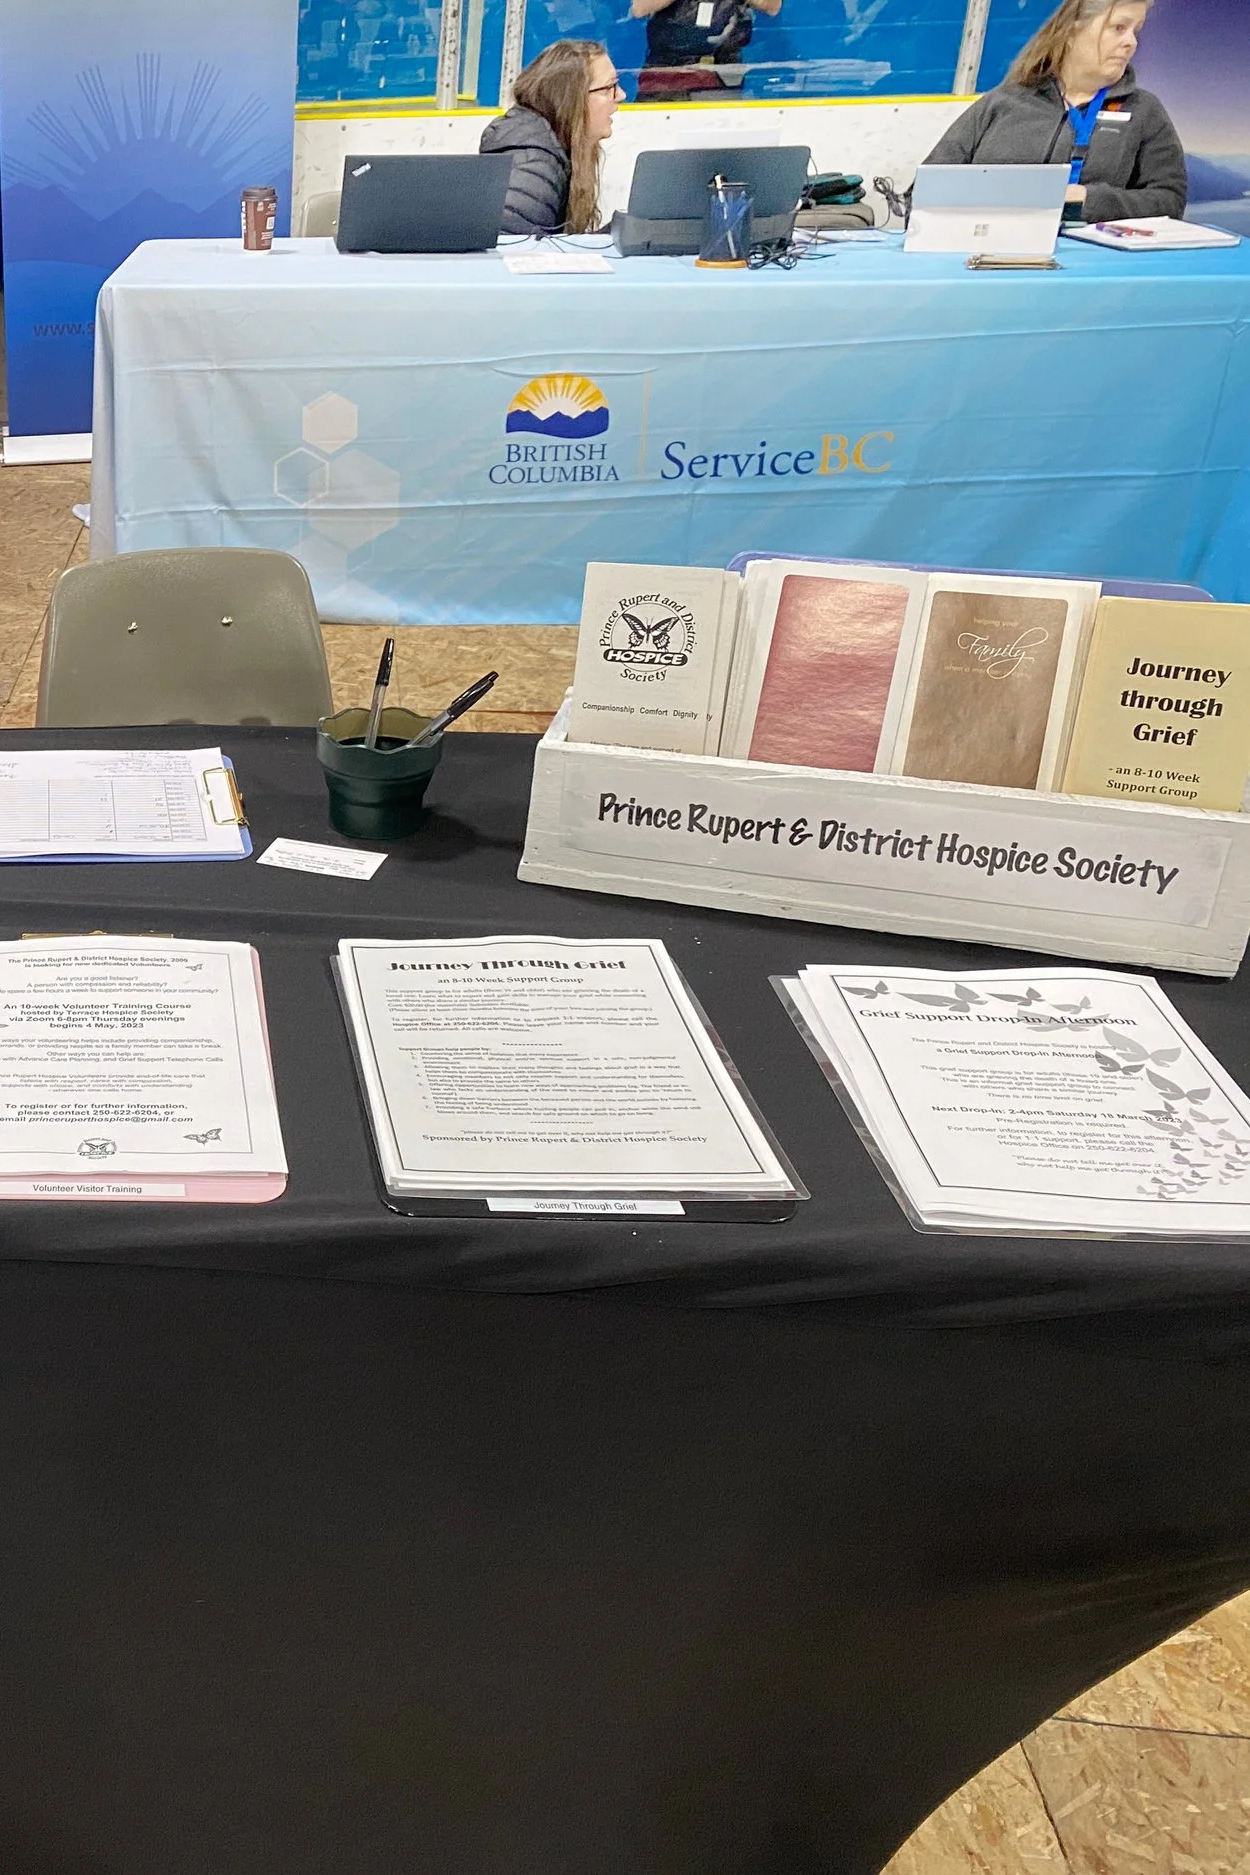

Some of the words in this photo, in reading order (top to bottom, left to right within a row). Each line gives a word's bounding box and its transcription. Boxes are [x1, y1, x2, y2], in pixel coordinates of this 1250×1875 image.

[506, 443, 608, 463] BRITISH
[660, 431, 894, 480] ServiceBC
[489, 464, 620, 485] COLUMBIA
[599, 610, 619, 648] Prince
[618, 593, 661, 611] Rupert
[661, 597, 686, 613] and
[681, 612, 698, 654] District
[607, 651, 683, 665] HOSPICE
[957, 626, 1049, 680] Family
[620, 668, 667, 683] Society
[1126, 657, 1233, 688] Journey
[581, 702, 635, 714] Companionship
[639, 707, 668, 716] Comfort
[673, 709, 698, 720] Dignity
[1120, 690, 1224, 719] through
[1133, 723, 1198, 746] Grief
[1115, 767, 1131, 775] an
[1134, 767, 1163, 779] 8-10
[1166, 771, 1201, 783] Week
[1106, 779, 1156, 794] Support
[1159, 785, 1198, 799] Group
[598, 793, 681, 829] Prince
[688, 803, 786, 843] Rupert
[789, 817, 813, 846] &
[817, 819, 932, 861] District
[936, 832, 1049, 876] Hospice
[1053, 846, 1179, 895] Society
[386, 962, 473, 971] Journey
[478, 960, 569, 970] Through
[574, 961, 627, 970] Grief
[859, 1010, 901, 1019] Grief
[905, 1012, 973, 1022] Support
[976, 1014, 1042, 1024] Drop-In
[1048, 1016, 1138, 1026] Afternoon
[960, 1106, 1005, 1114] Drop-In:
[1046, 1110, 1097, 1119] Saturday
[1116, 1113, 1153, 1121] March
[1156, 1116, 1183, 1124] 2023
[669, 1136, 708, 1144] Society
[32, 1184, 74, 1192] Volunteer
[106, 1185, 142, 1194] Training
[534, 1201, 570, 1210] Journey
[572, 1202, 613, 1210] Through
[614, 1202, 638, 1210] Grief
